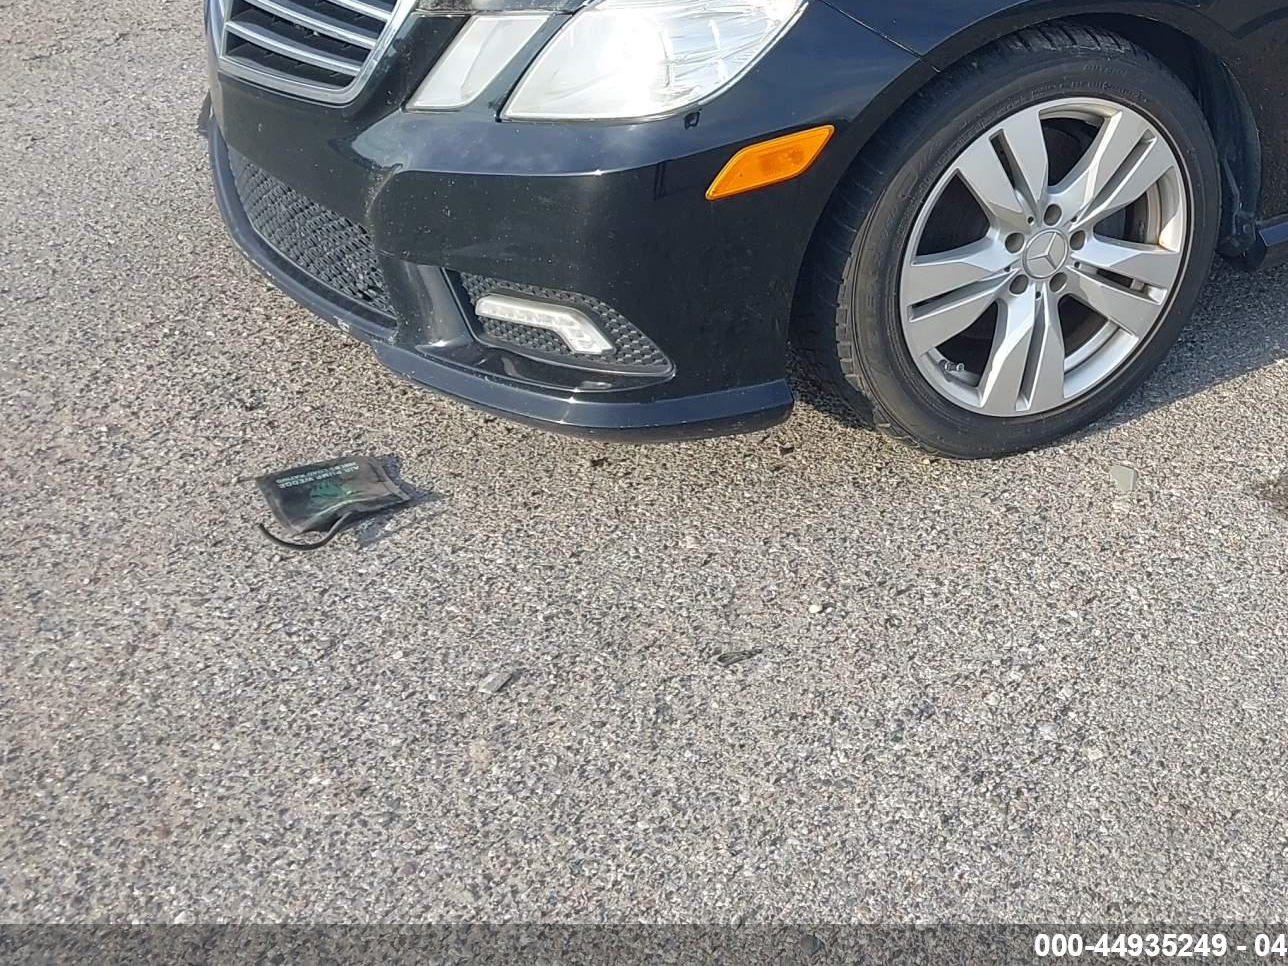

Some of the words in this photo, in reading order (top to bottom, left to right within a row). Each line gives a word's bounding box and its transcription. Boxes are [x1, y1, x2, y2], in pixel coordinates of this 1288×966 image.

[344, 464, 360, 474] AIR
[315, 470, 343, 480] PUMP
[279, 477, 315, 489] WEDGE
